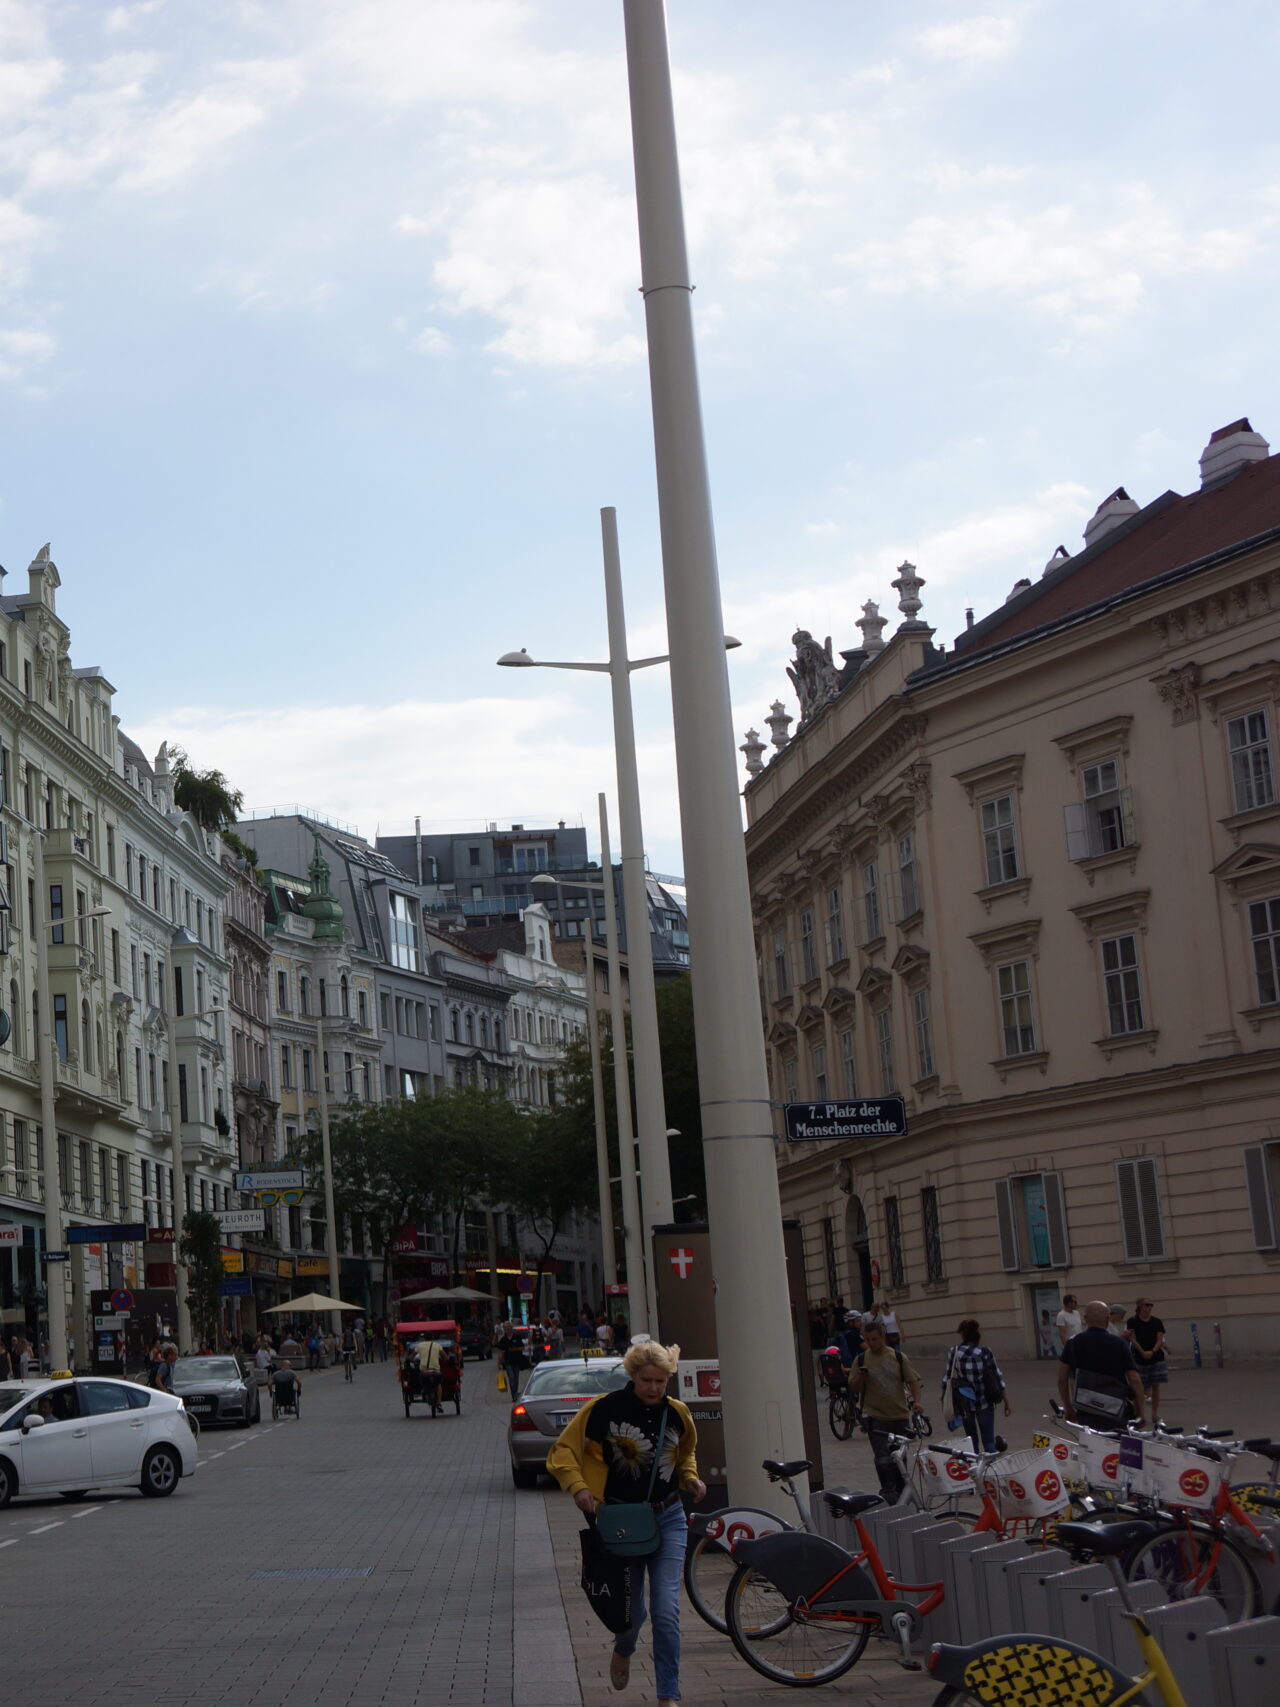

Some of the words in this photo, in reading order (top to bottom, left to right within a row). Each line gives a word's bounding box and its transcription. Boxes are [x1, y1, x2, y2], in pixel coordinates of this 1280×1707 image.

[825, 1103, 856, 1119] Platz
[860, 1103, 881, 1117] der
[796, 1119, 897, 1137] Menschenrechte
